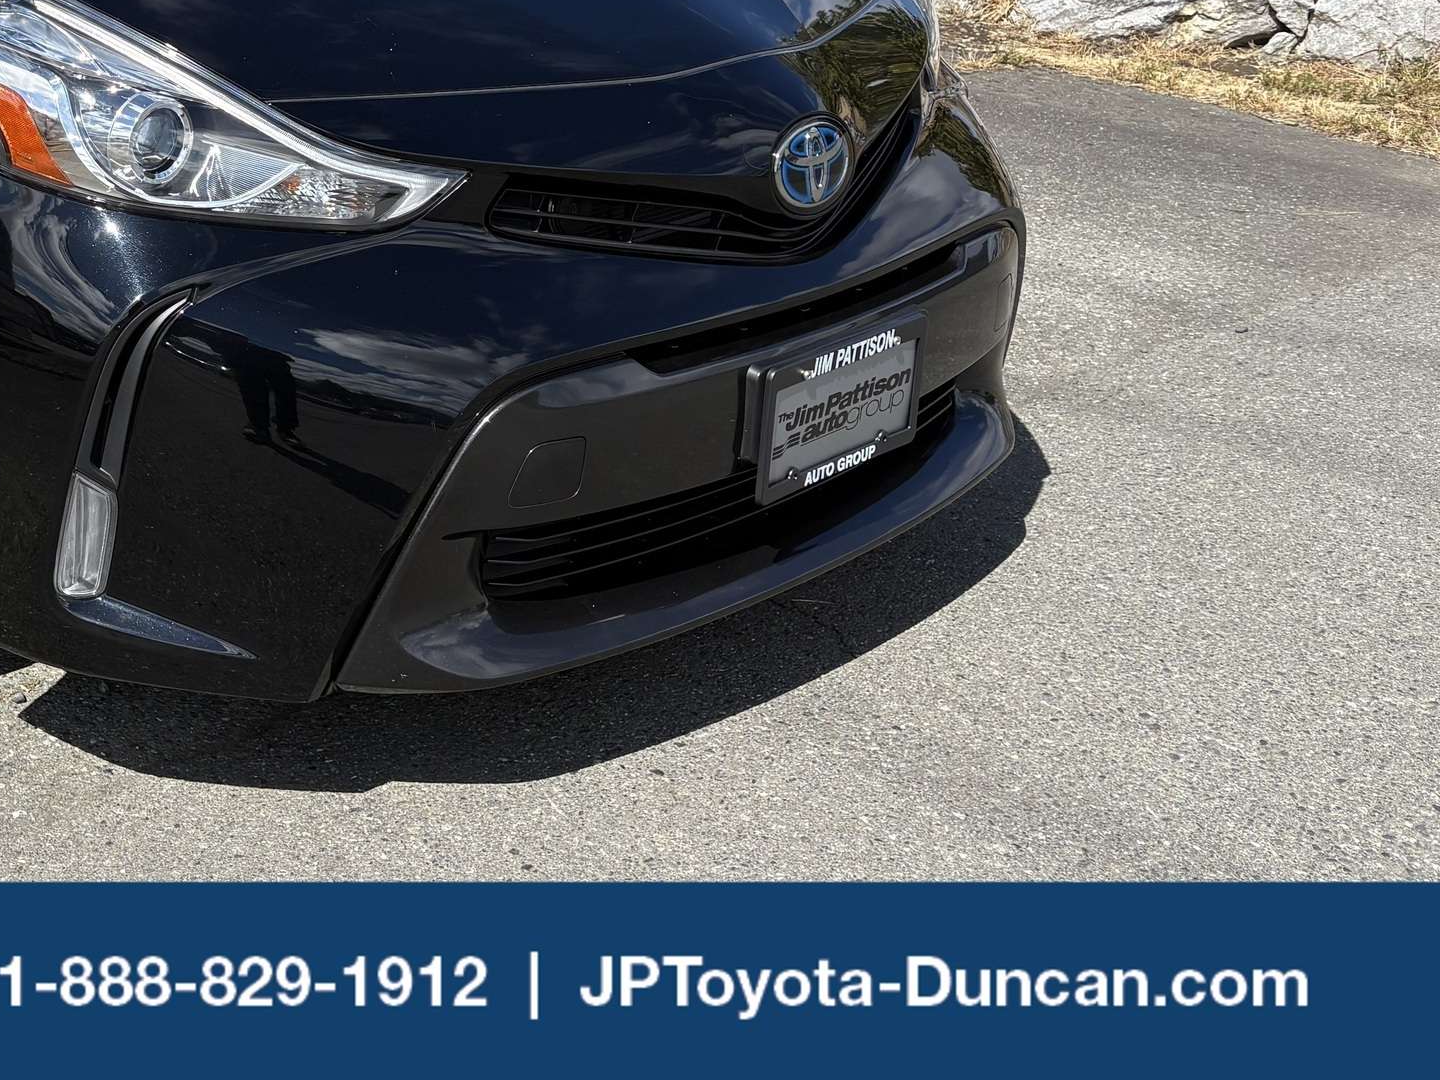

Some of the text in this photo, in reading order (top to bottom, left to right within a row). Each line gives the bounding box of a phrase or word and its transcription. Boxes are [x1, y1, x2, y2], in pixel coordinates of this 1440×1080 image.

[811, 329, 896, 379] JIM PATTISON
[804, 445, 876, 486] AUTO GROUP
